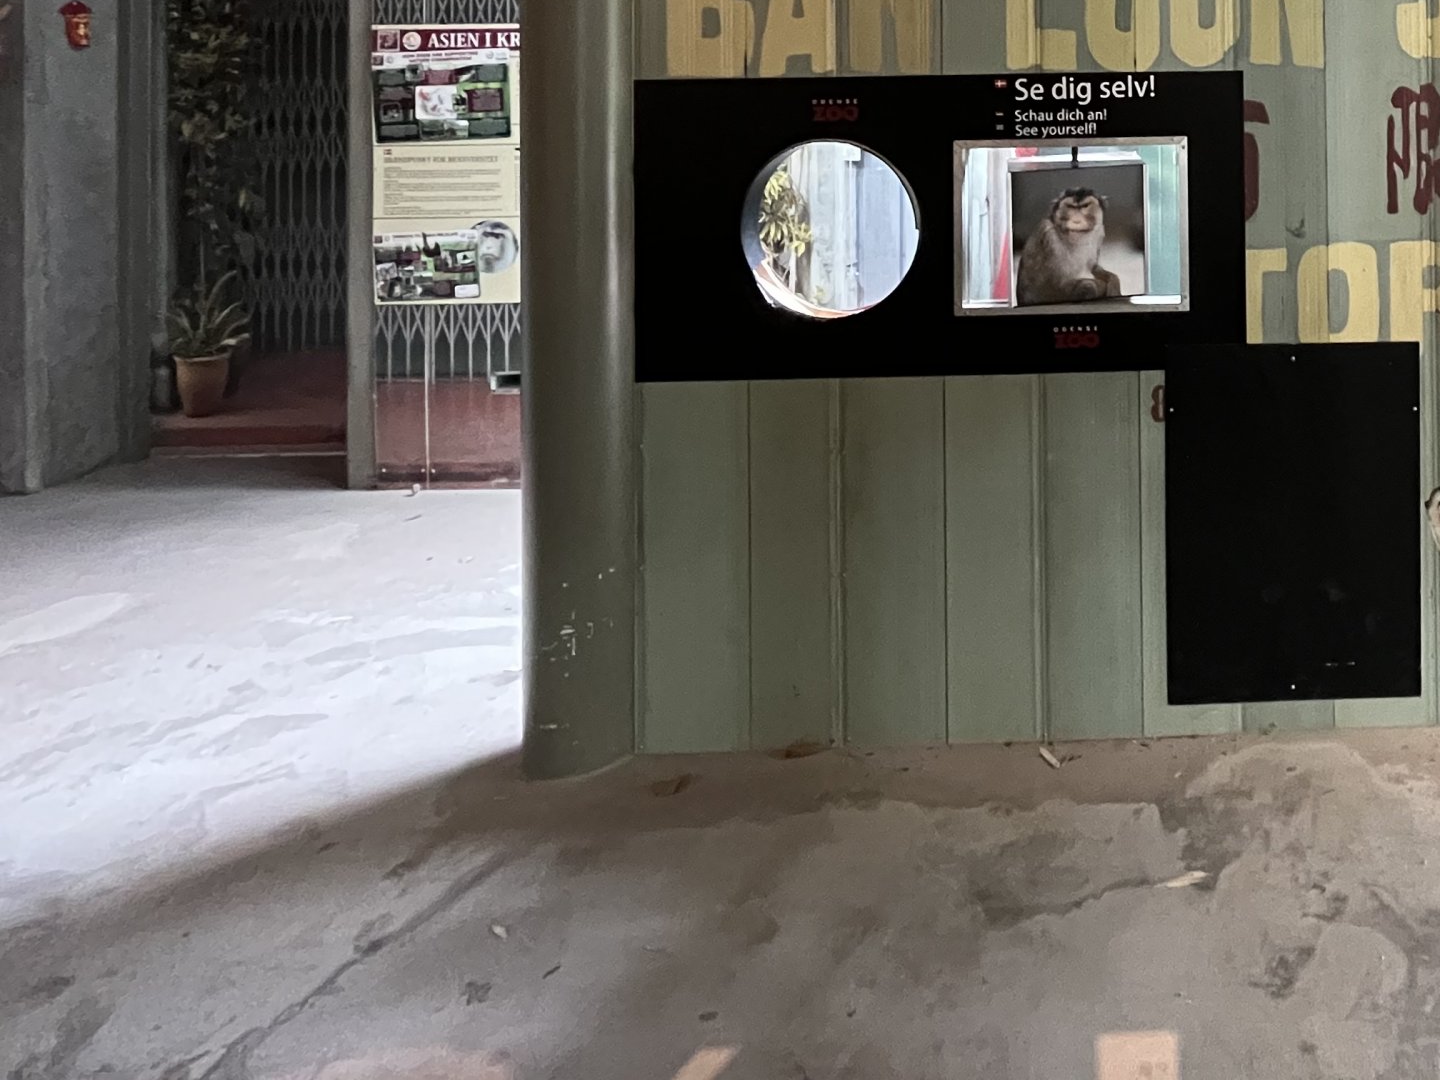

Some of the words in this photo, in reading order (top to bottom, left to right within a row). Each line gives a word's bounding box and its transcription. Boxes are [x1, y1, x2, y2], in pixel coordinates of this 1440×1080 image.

[427, 32, 480, 48] ASIEN
[485, 32, 492, 47] I
[1014, 78, 1045, 101] Se
[1051, 76, 1092, 105] dig
[1100, 75, 1156, 99] selv!
[1014, 108, 1053, 122] Schau
[1056, 108, 1084, 121] dich
[1087, 108, 1107, 121] an!
[1015, 124, 1039, 137] See
[1041, 123, 1097, 139] yourself!
